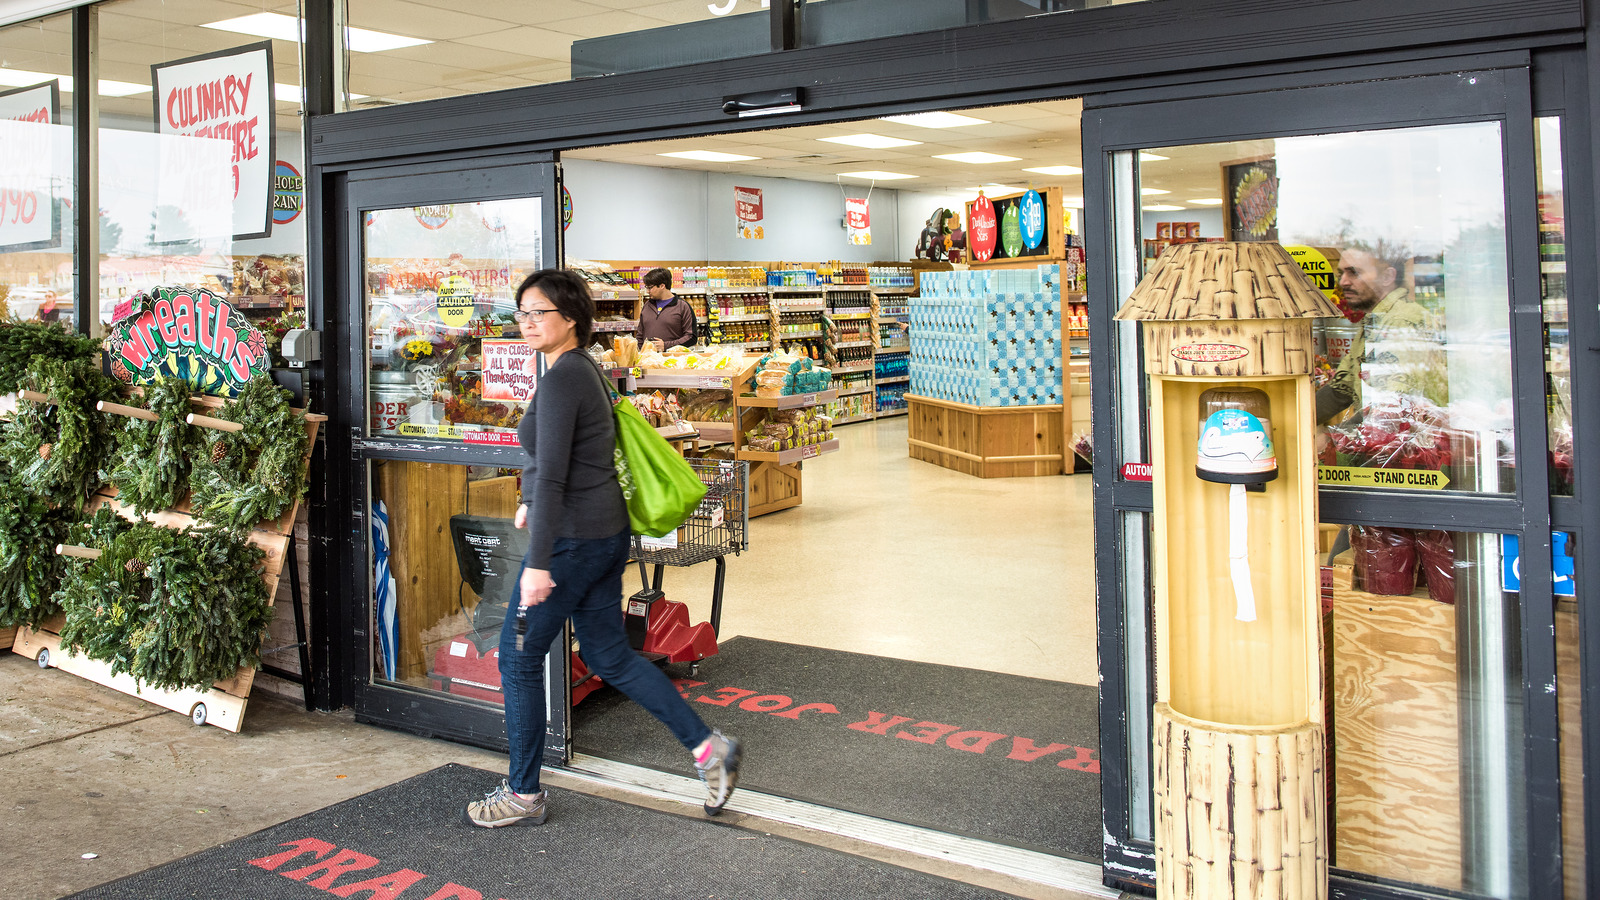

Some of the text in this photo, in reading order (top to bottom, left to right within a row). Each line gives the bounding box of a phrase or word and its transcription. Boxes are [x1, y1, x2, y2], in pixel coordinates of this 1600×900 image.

[166, 72, 253, 129] CULINARY
[275, 176, 302, 190] HOLE
[274, 194, 297, 209] RAIN
[378, 271, 445, 290] TRADING
[440, 287, 471, 295] AUTOMATIC
[439, 296, 473, 307] CAUTION
[448, 308, 464, 316] DOOR
[121, 292, 257, 384] wreaths
[496, 347, 508, 355] are
[508, 344, 535, 356] CLOSED
[490, 357, 526, 371] ALL DAY
[483, 370, 535, 389] Thanksgiving
[512, 385, 529, 401] Day
[403, 425, 427, 434] AUTOMATIC
[426, 426, 439, 435] DOOR
[463, 431, 487, 442] AUTOMATIC
[488, 433, 501, 442] DOOR
[1125, 464, 1153, 477] AUTOM
[1325, 469, 1351, 482] DOOR
[1374, 471, 1405, 484] STAND
[1407, 472, 1439, 486] CLEAR
[846, 710, 1101, 774] RADER
